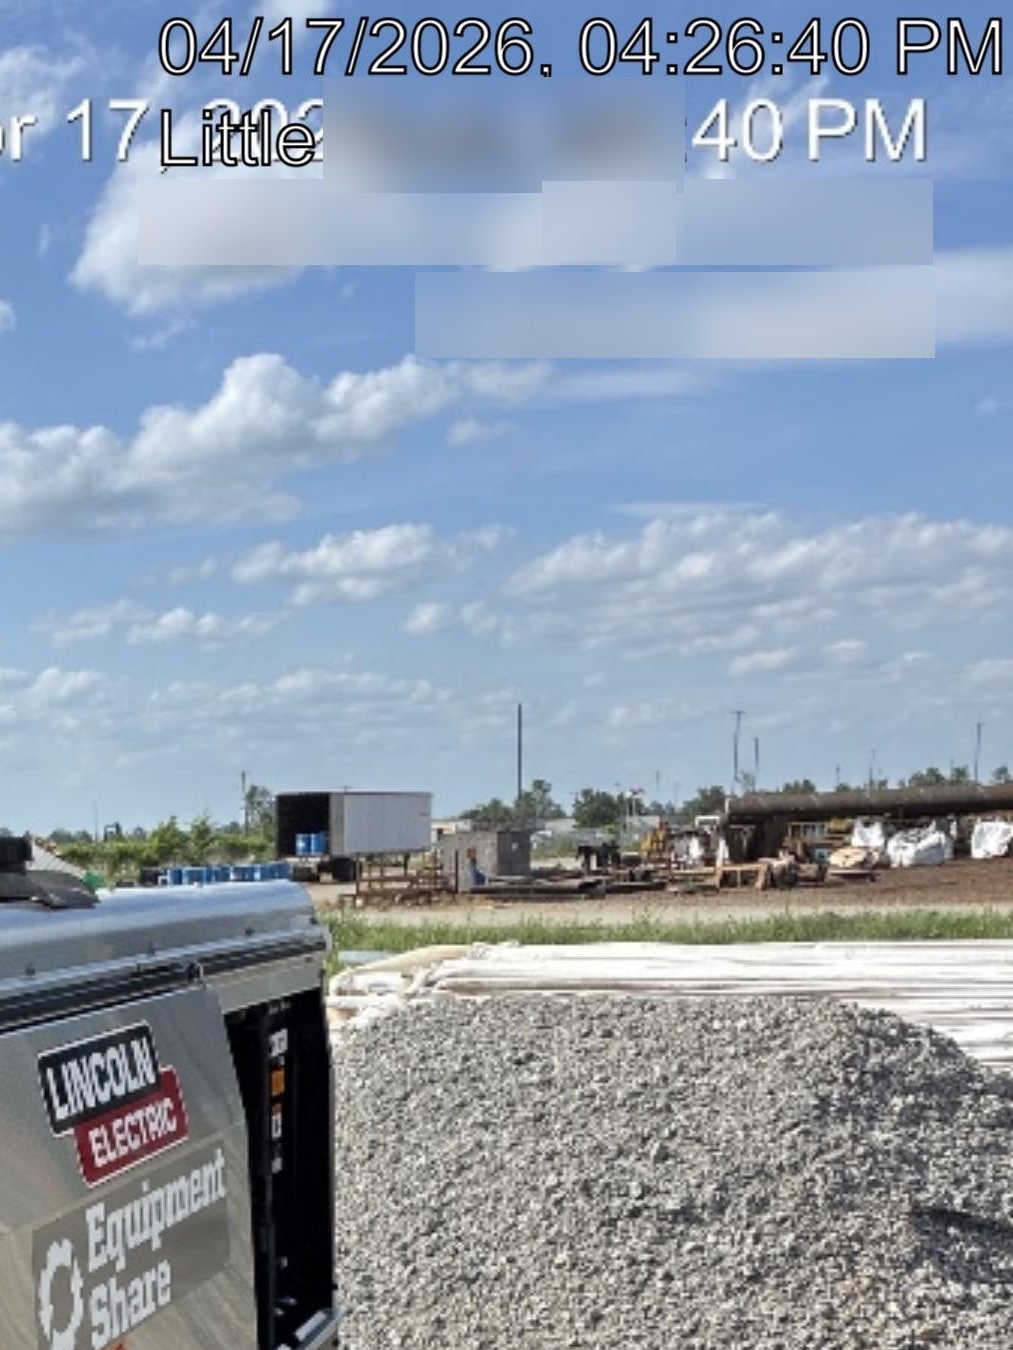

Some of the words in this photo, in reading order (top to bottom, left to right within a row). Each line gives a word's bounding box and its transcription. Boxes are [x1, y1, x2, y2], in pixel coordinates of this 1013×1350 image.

[46, 1035, 157, 1120] LINCOLN
[89, 1097, 177, 1168] ELECTRIC
[85, 1150, 226, 1271] Equipment
[91, 1260, 172, 1350] Share
